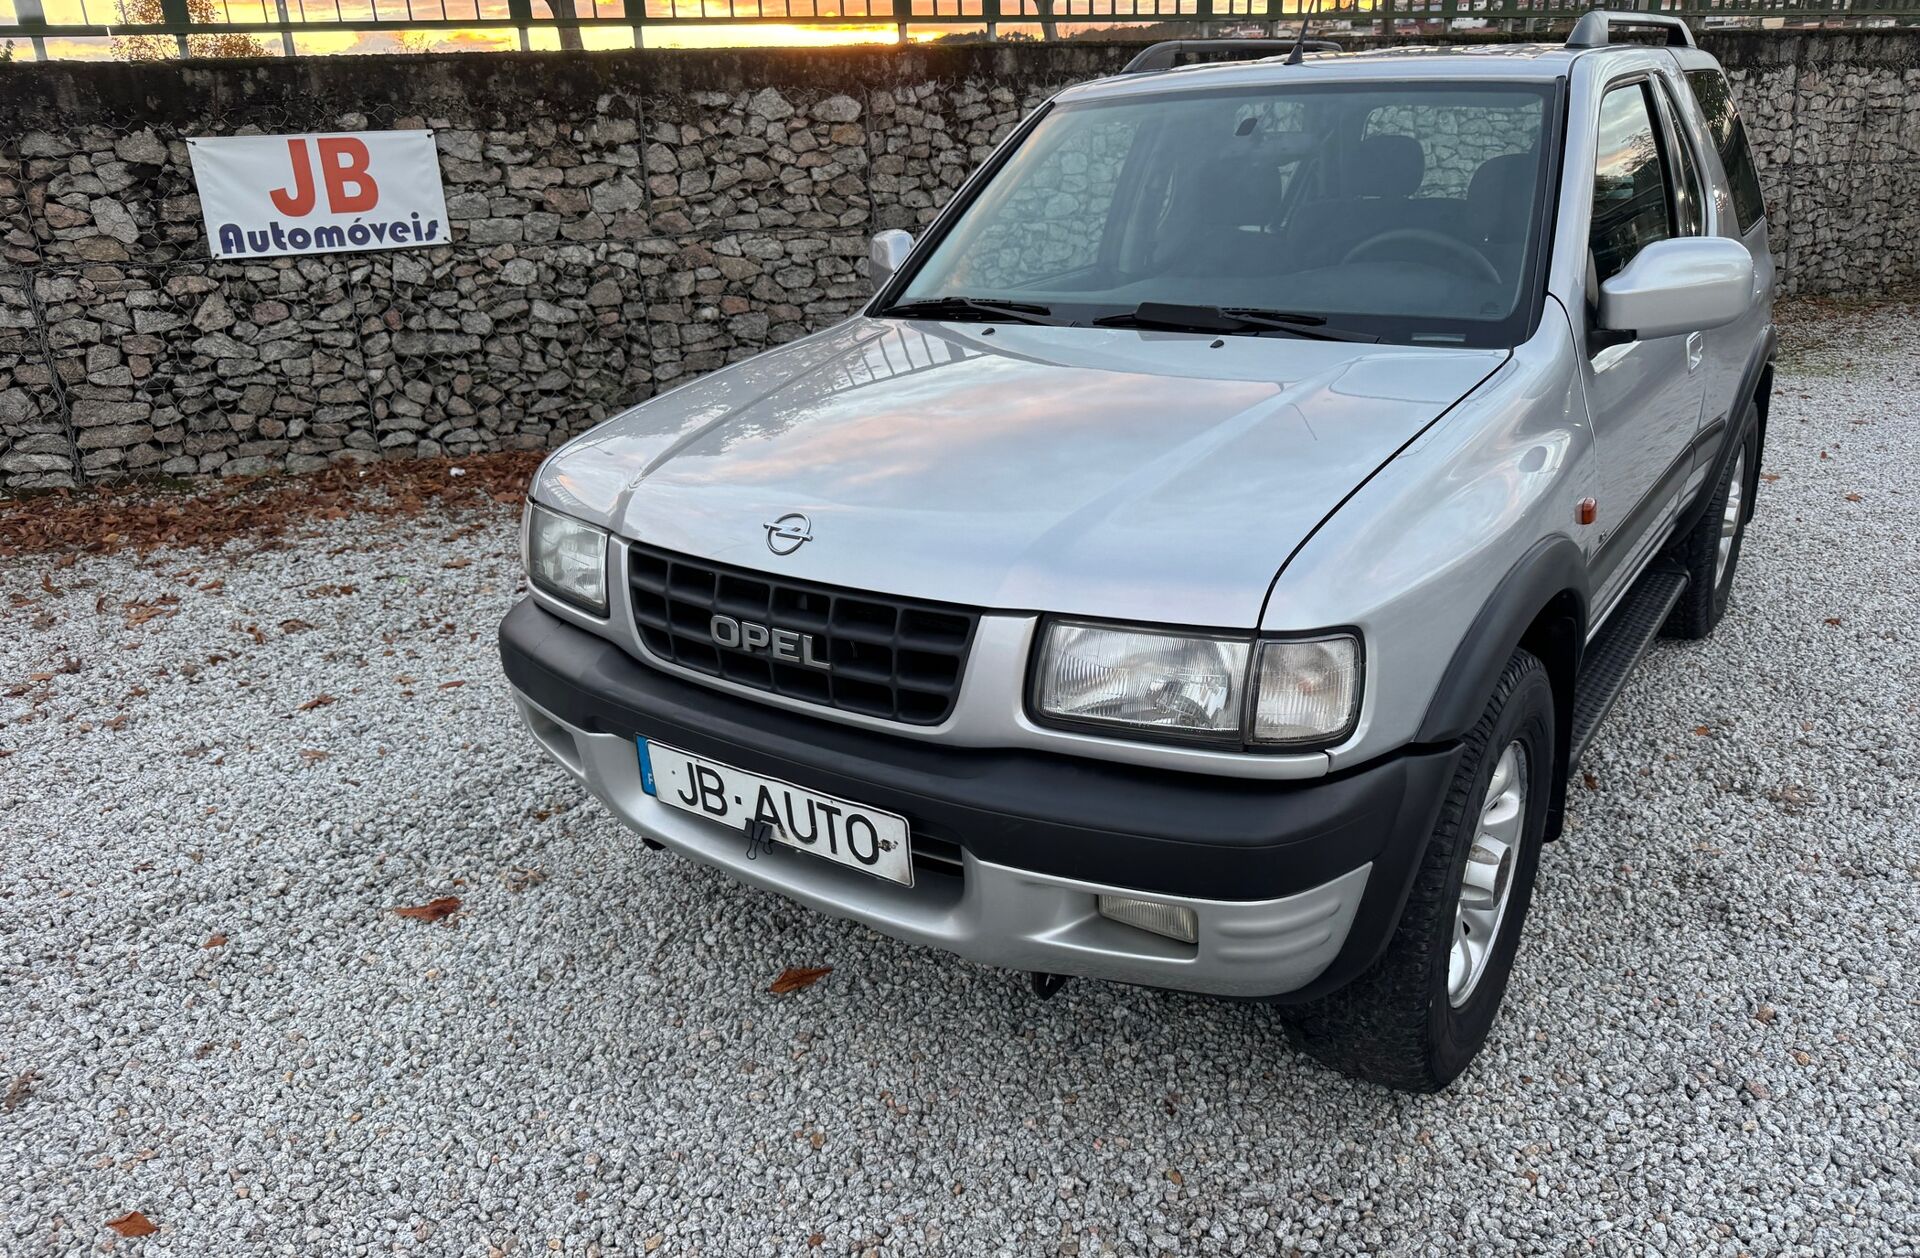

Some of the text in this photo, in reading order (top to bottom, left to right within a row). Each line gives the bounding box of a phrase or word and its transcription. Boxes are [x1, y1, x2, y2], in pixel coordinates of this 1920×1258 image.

[269, 137, 379, 217] JB
[219, 212, 438, 254] Automóveis
[710, 614, 832, 670] OPEL
